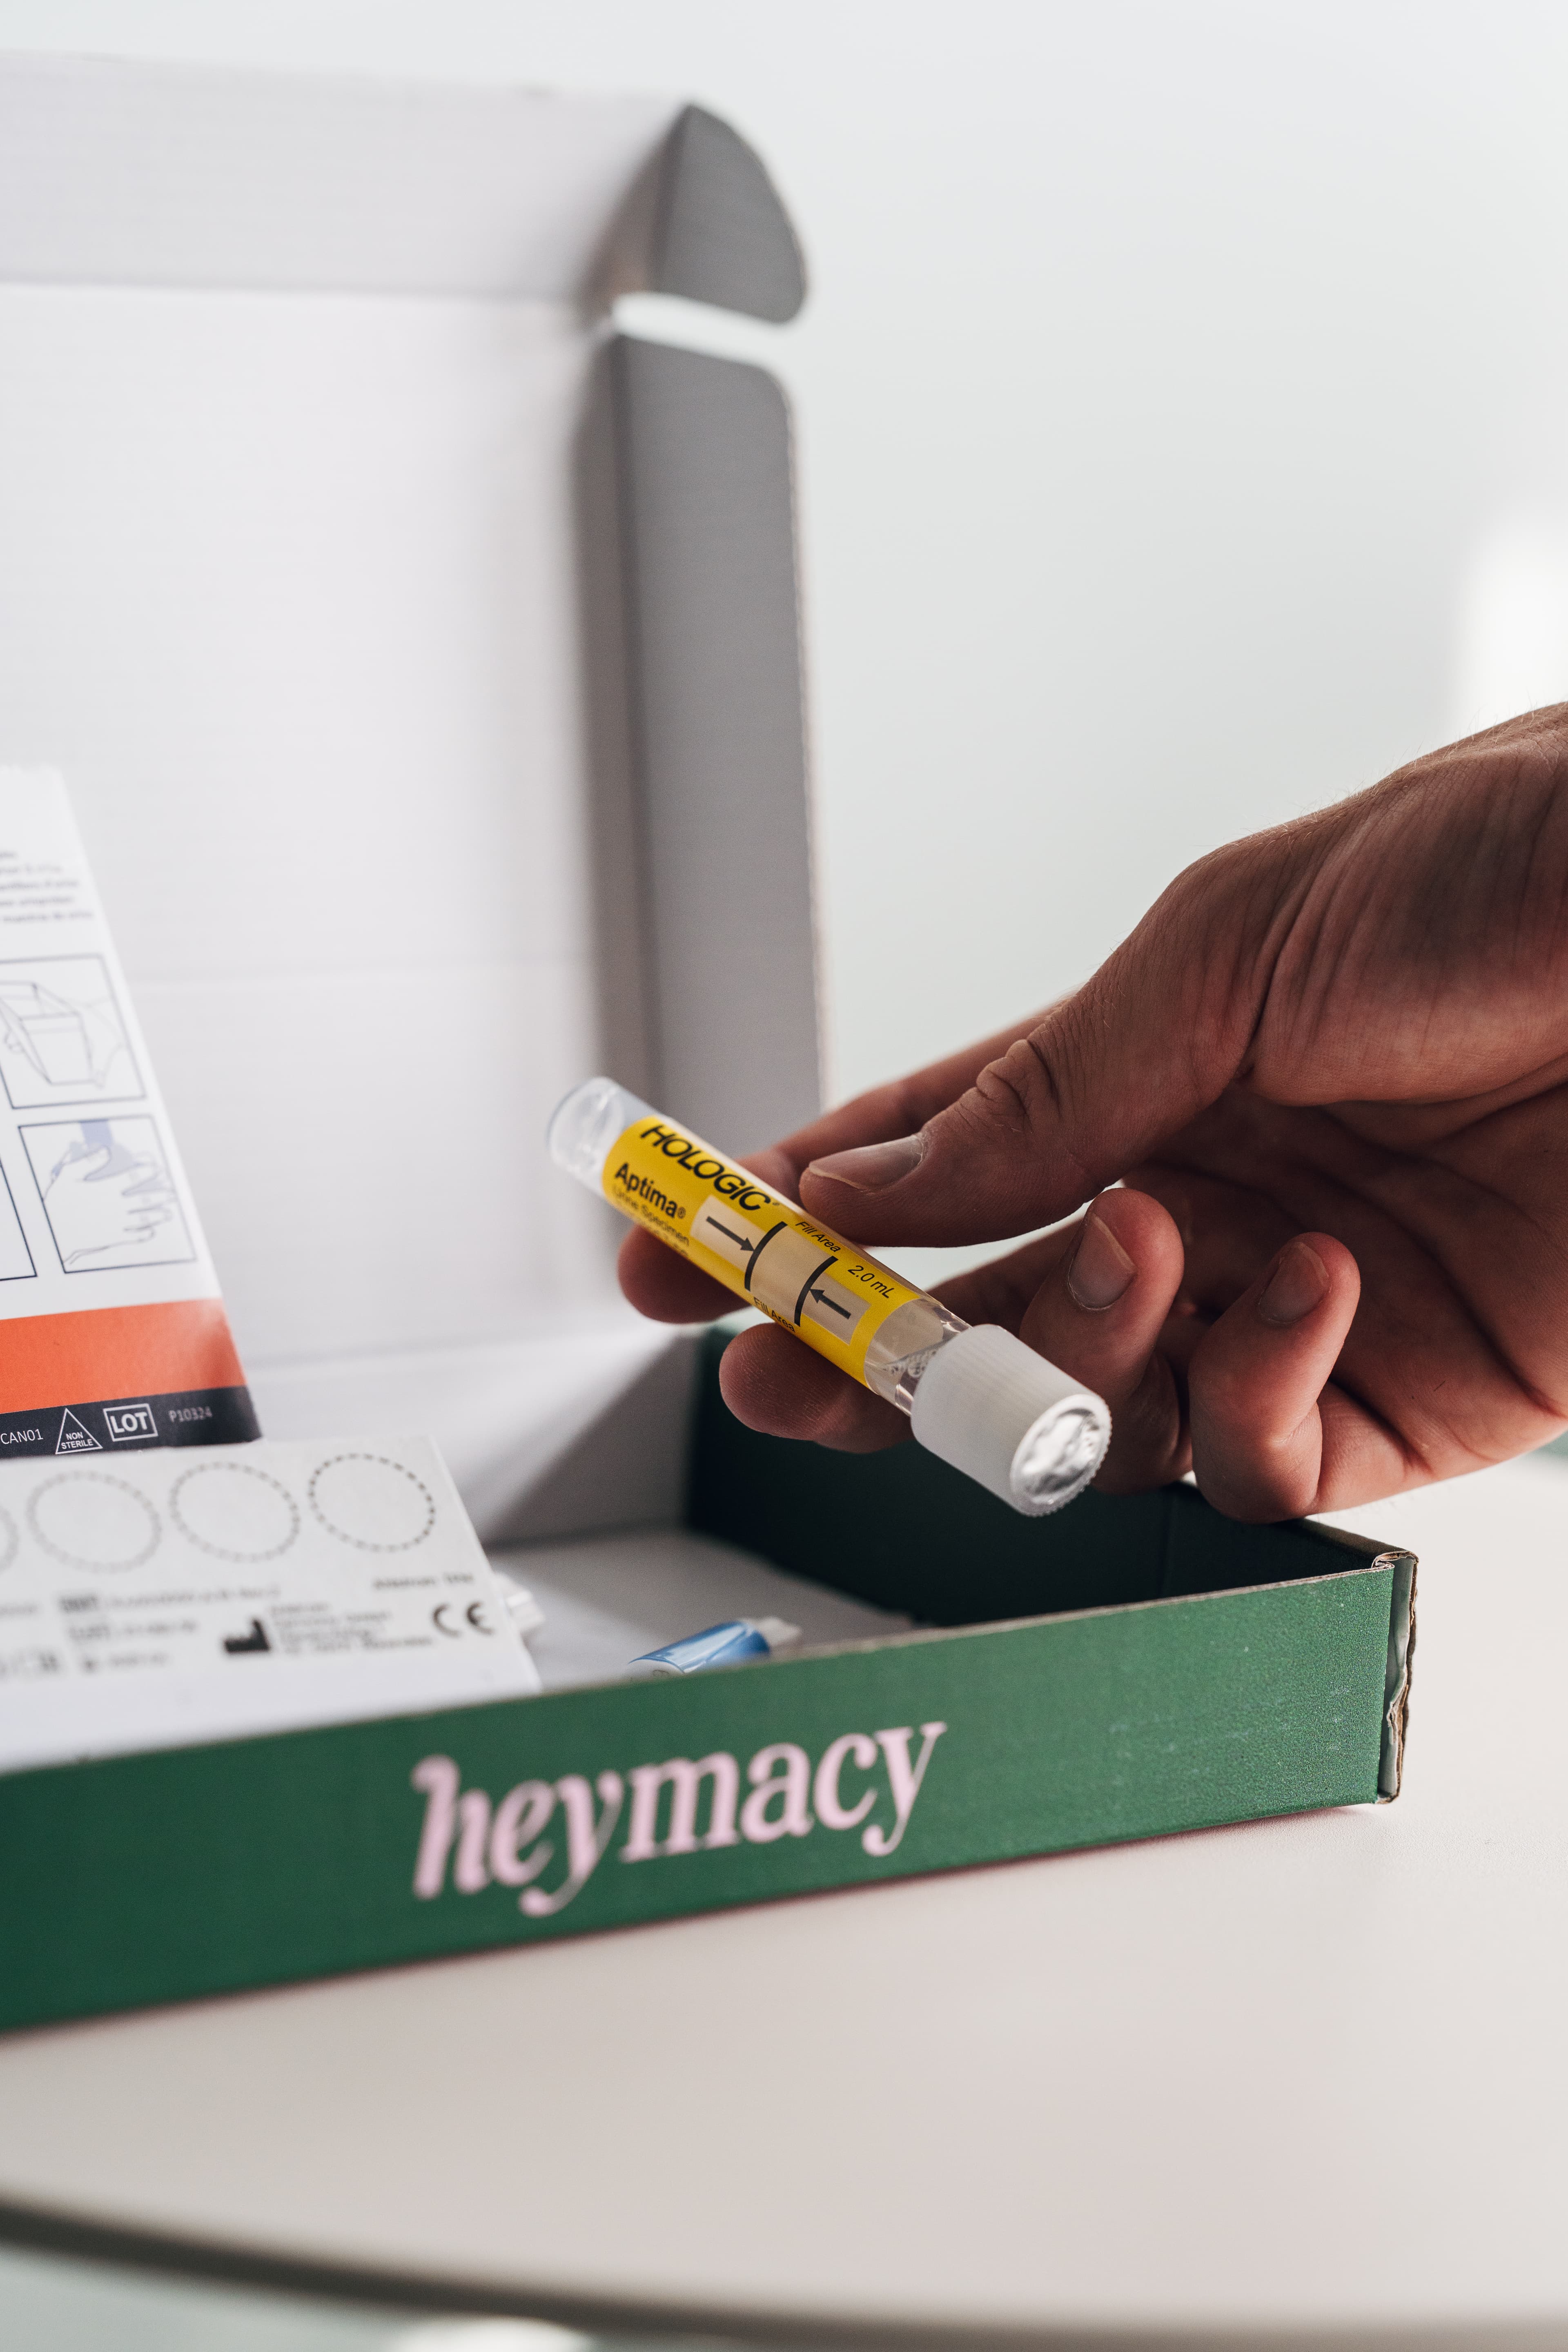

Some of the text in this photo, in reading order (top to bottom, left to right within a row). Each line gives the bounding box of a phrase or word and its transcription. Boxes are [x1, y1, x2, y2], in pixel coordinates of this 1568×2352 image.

[640, 1125, 771, 1211] HOLOGIC
[795, 1221, 841, 1252] Fill Area
[848, 1265, 895, 1298] 2.0 mL
[754, 1296, 796, 1333] Fill Area
[66, 1432, 84, 1440] NON
[110, 1412, 148, 1433] LOT
[61, 1439, 94, 1449] STERILE
[412, 1721, 947, 1918] heymacy
